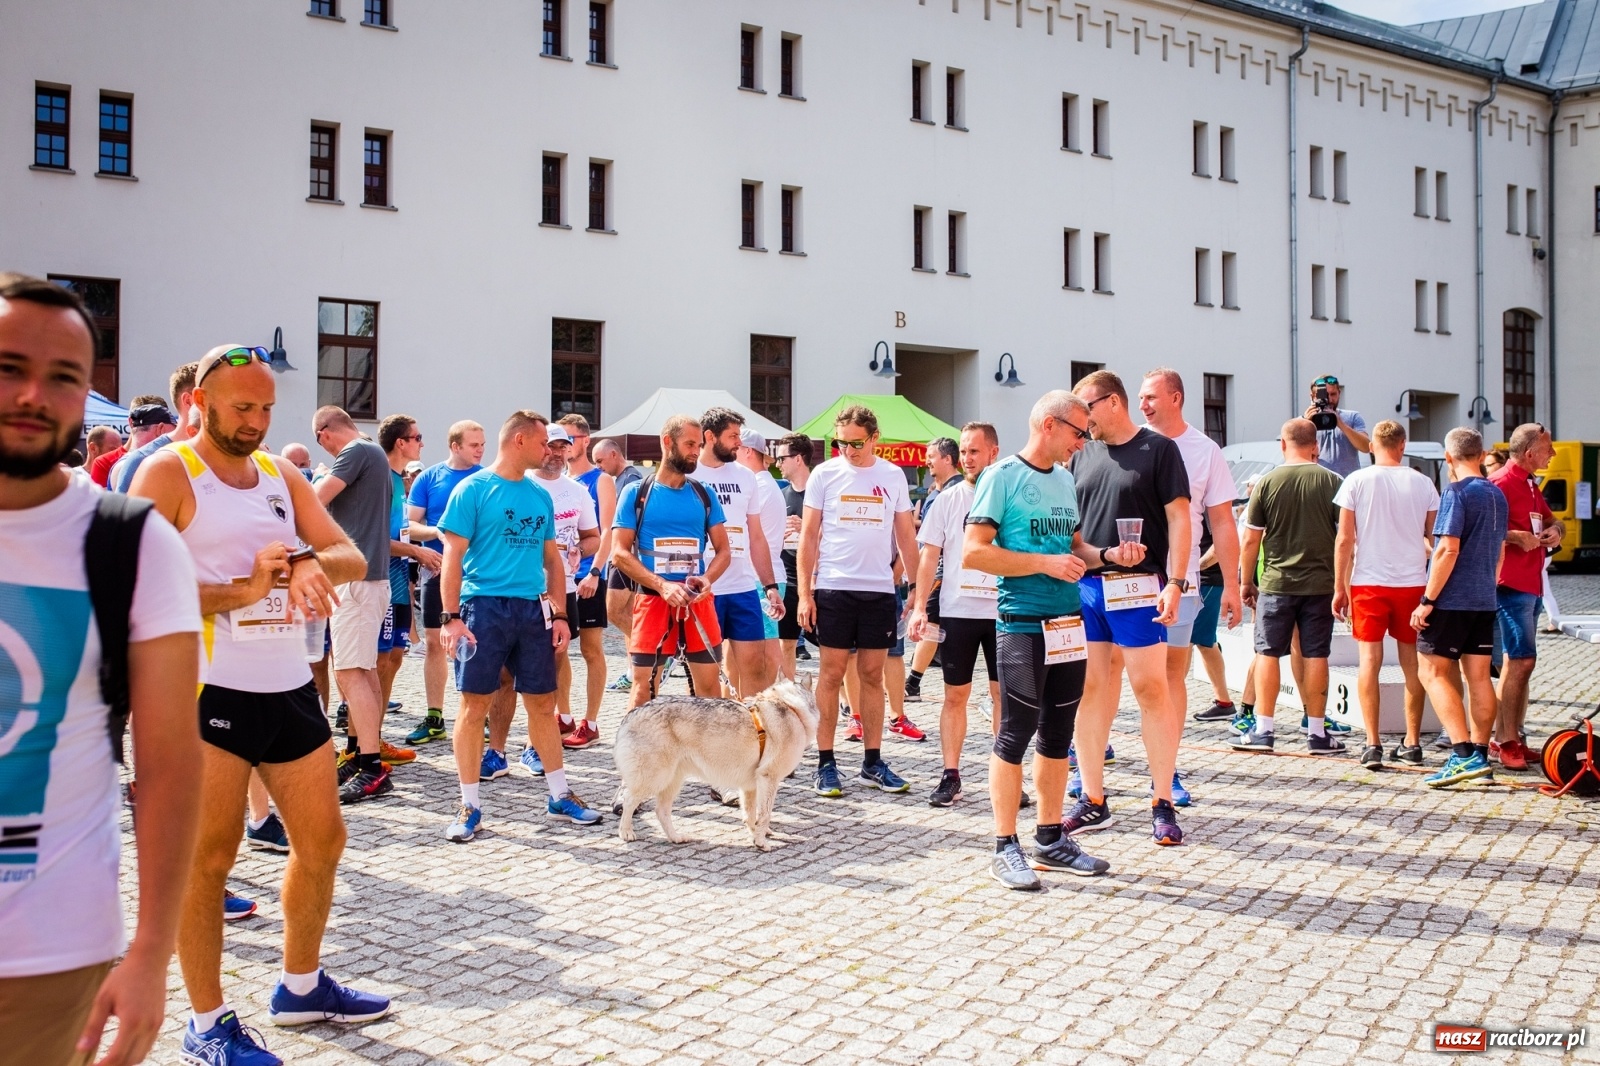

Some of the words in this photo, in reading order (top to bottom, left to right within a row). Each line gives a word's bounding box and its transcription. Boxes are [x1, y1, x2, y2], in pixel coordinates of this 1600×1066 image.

[895, 310, 906, 328] B
[719, 483, 741, 494] HUTA
[856, 506, 868, 515] 47
[1050, 506, 1063, 516] JUST
[981, 574, 988, 584] 7
[1124, 582, 1139, 594] 18
[264, 596, 282, 613] 39
[1062, 633, 1072, 645] 14
[1337, 683, 1349, 715] 3
